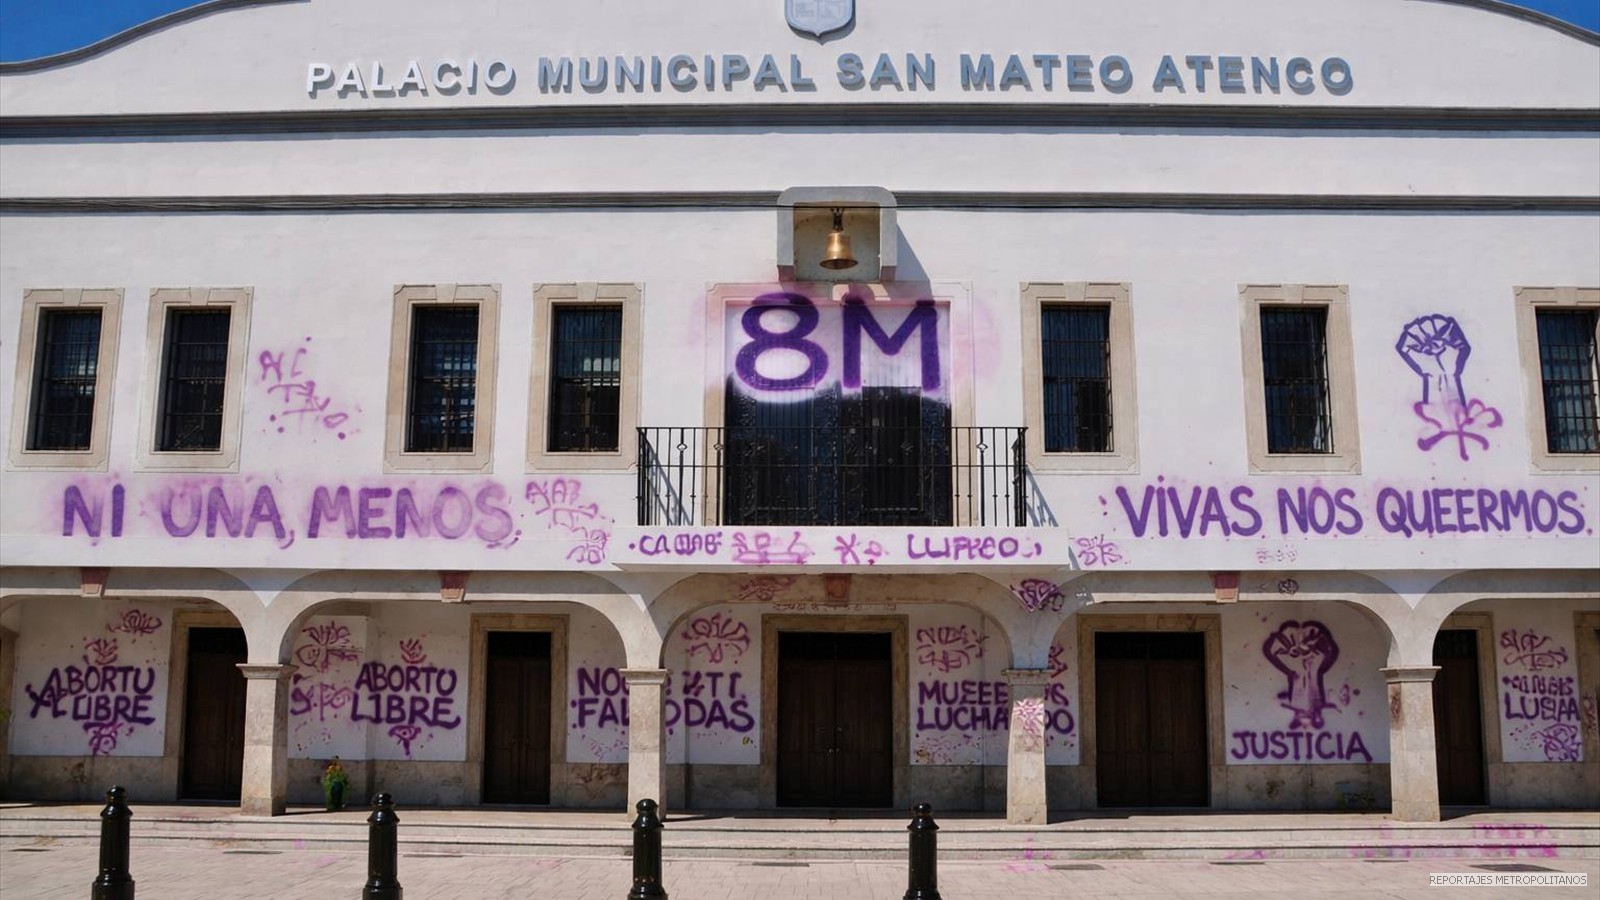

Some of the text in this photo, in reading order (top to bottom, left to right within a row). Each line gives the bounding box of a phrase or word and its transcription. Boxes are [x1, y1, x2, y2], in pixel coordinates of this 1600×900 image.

[307, 53, 1352, 97] PALACIO MUNICIPAL SAN MATEO ATENCO
[735, 291, 941, 392] 8M
[62, 484, 125, 538] NI
[1277, 486, 1363, 535] NOS
[355, 662, 457, 696] ABORTO
[351, 692, 461, 729] LIBRE
[1231, 731, 1373, 763] JUSTICIA
